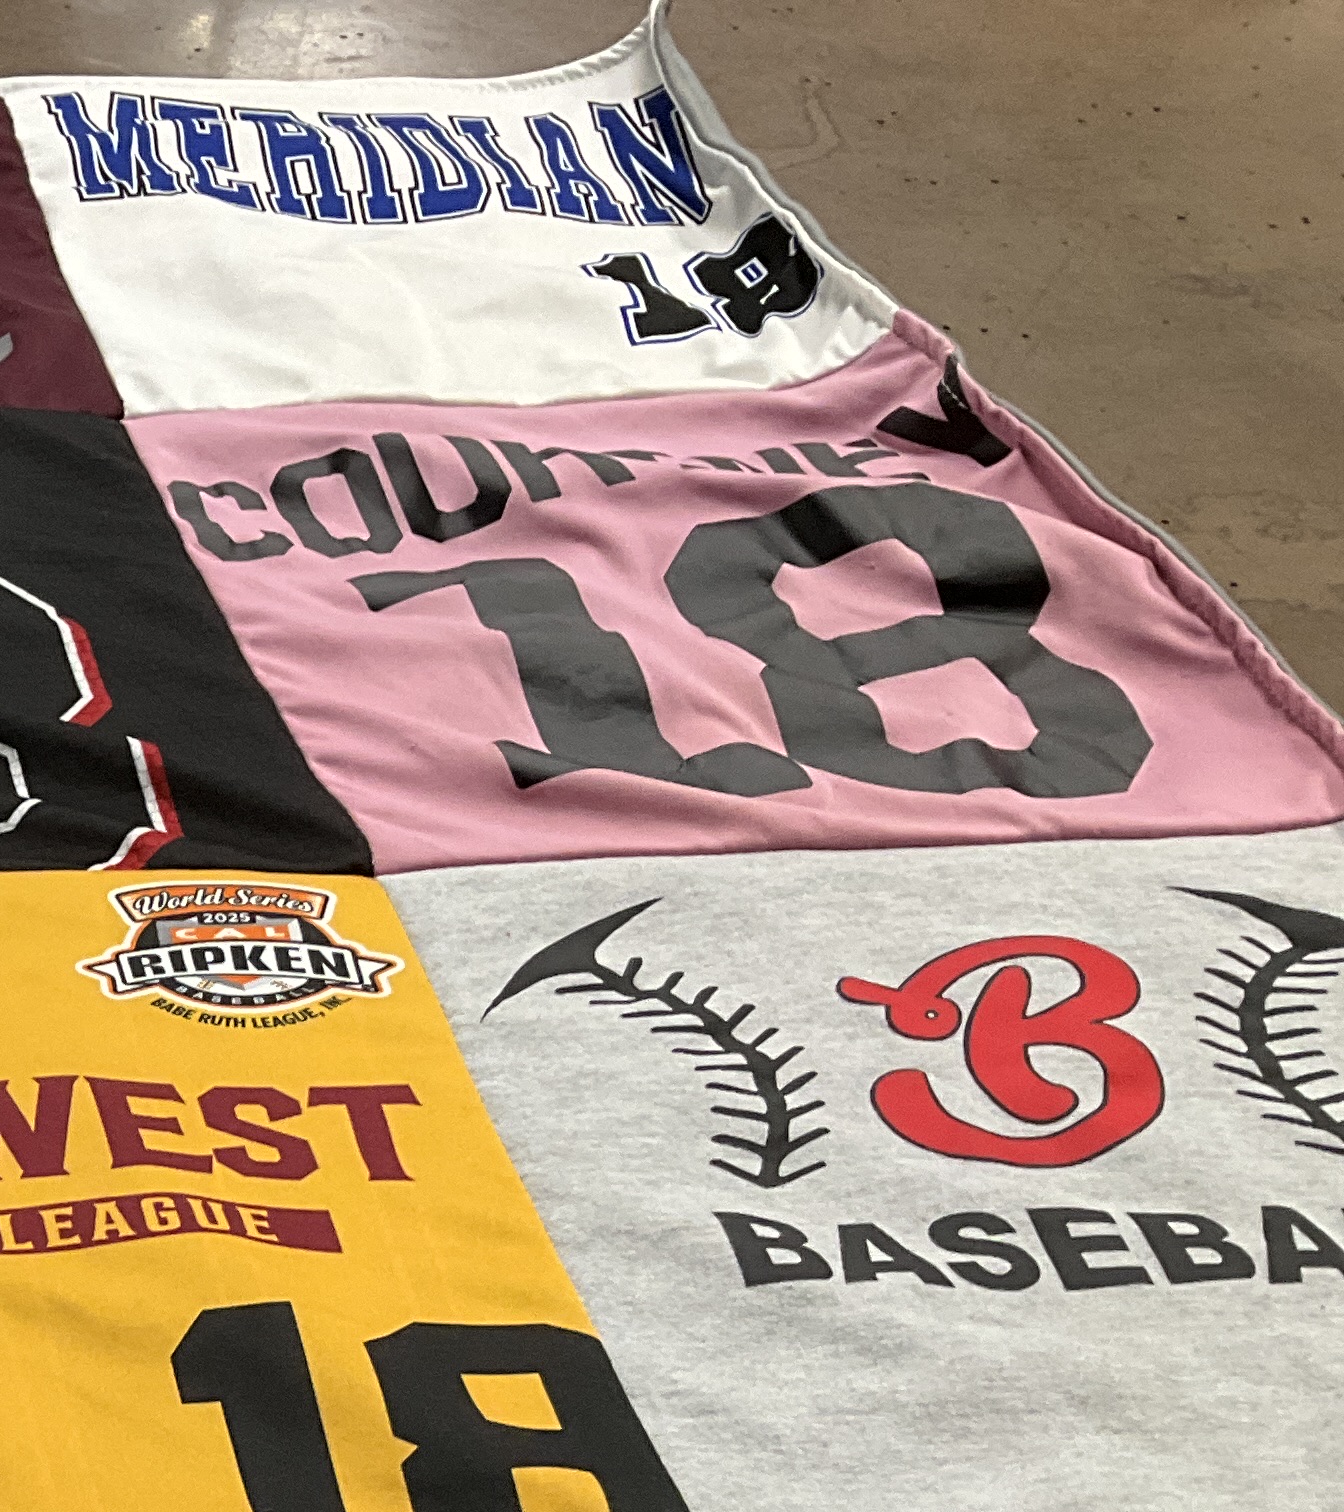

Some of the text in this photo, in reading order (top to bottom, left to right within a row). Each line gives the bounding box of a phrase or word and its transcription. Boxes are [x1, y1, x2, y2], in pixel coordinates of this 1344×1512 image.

[45, 88, 713, 225] MERIDIAN
[579, 211, 825, 345] 18
[347, 480, 1156, 799] 18
[134, 888, 314, 915] World Series
[203, 912, 251, 924] 2025
[127, 945, 350, 980] RIPKEN
[151, 997, 194, 1020] BABE
[198, 1012, 247, 1029] RUTH
[251, 1007, 326, 1029] LEAGUE,
[836, 934, 1165, 1168] B
[715, 1205, 1344, 1292] BASEBA
